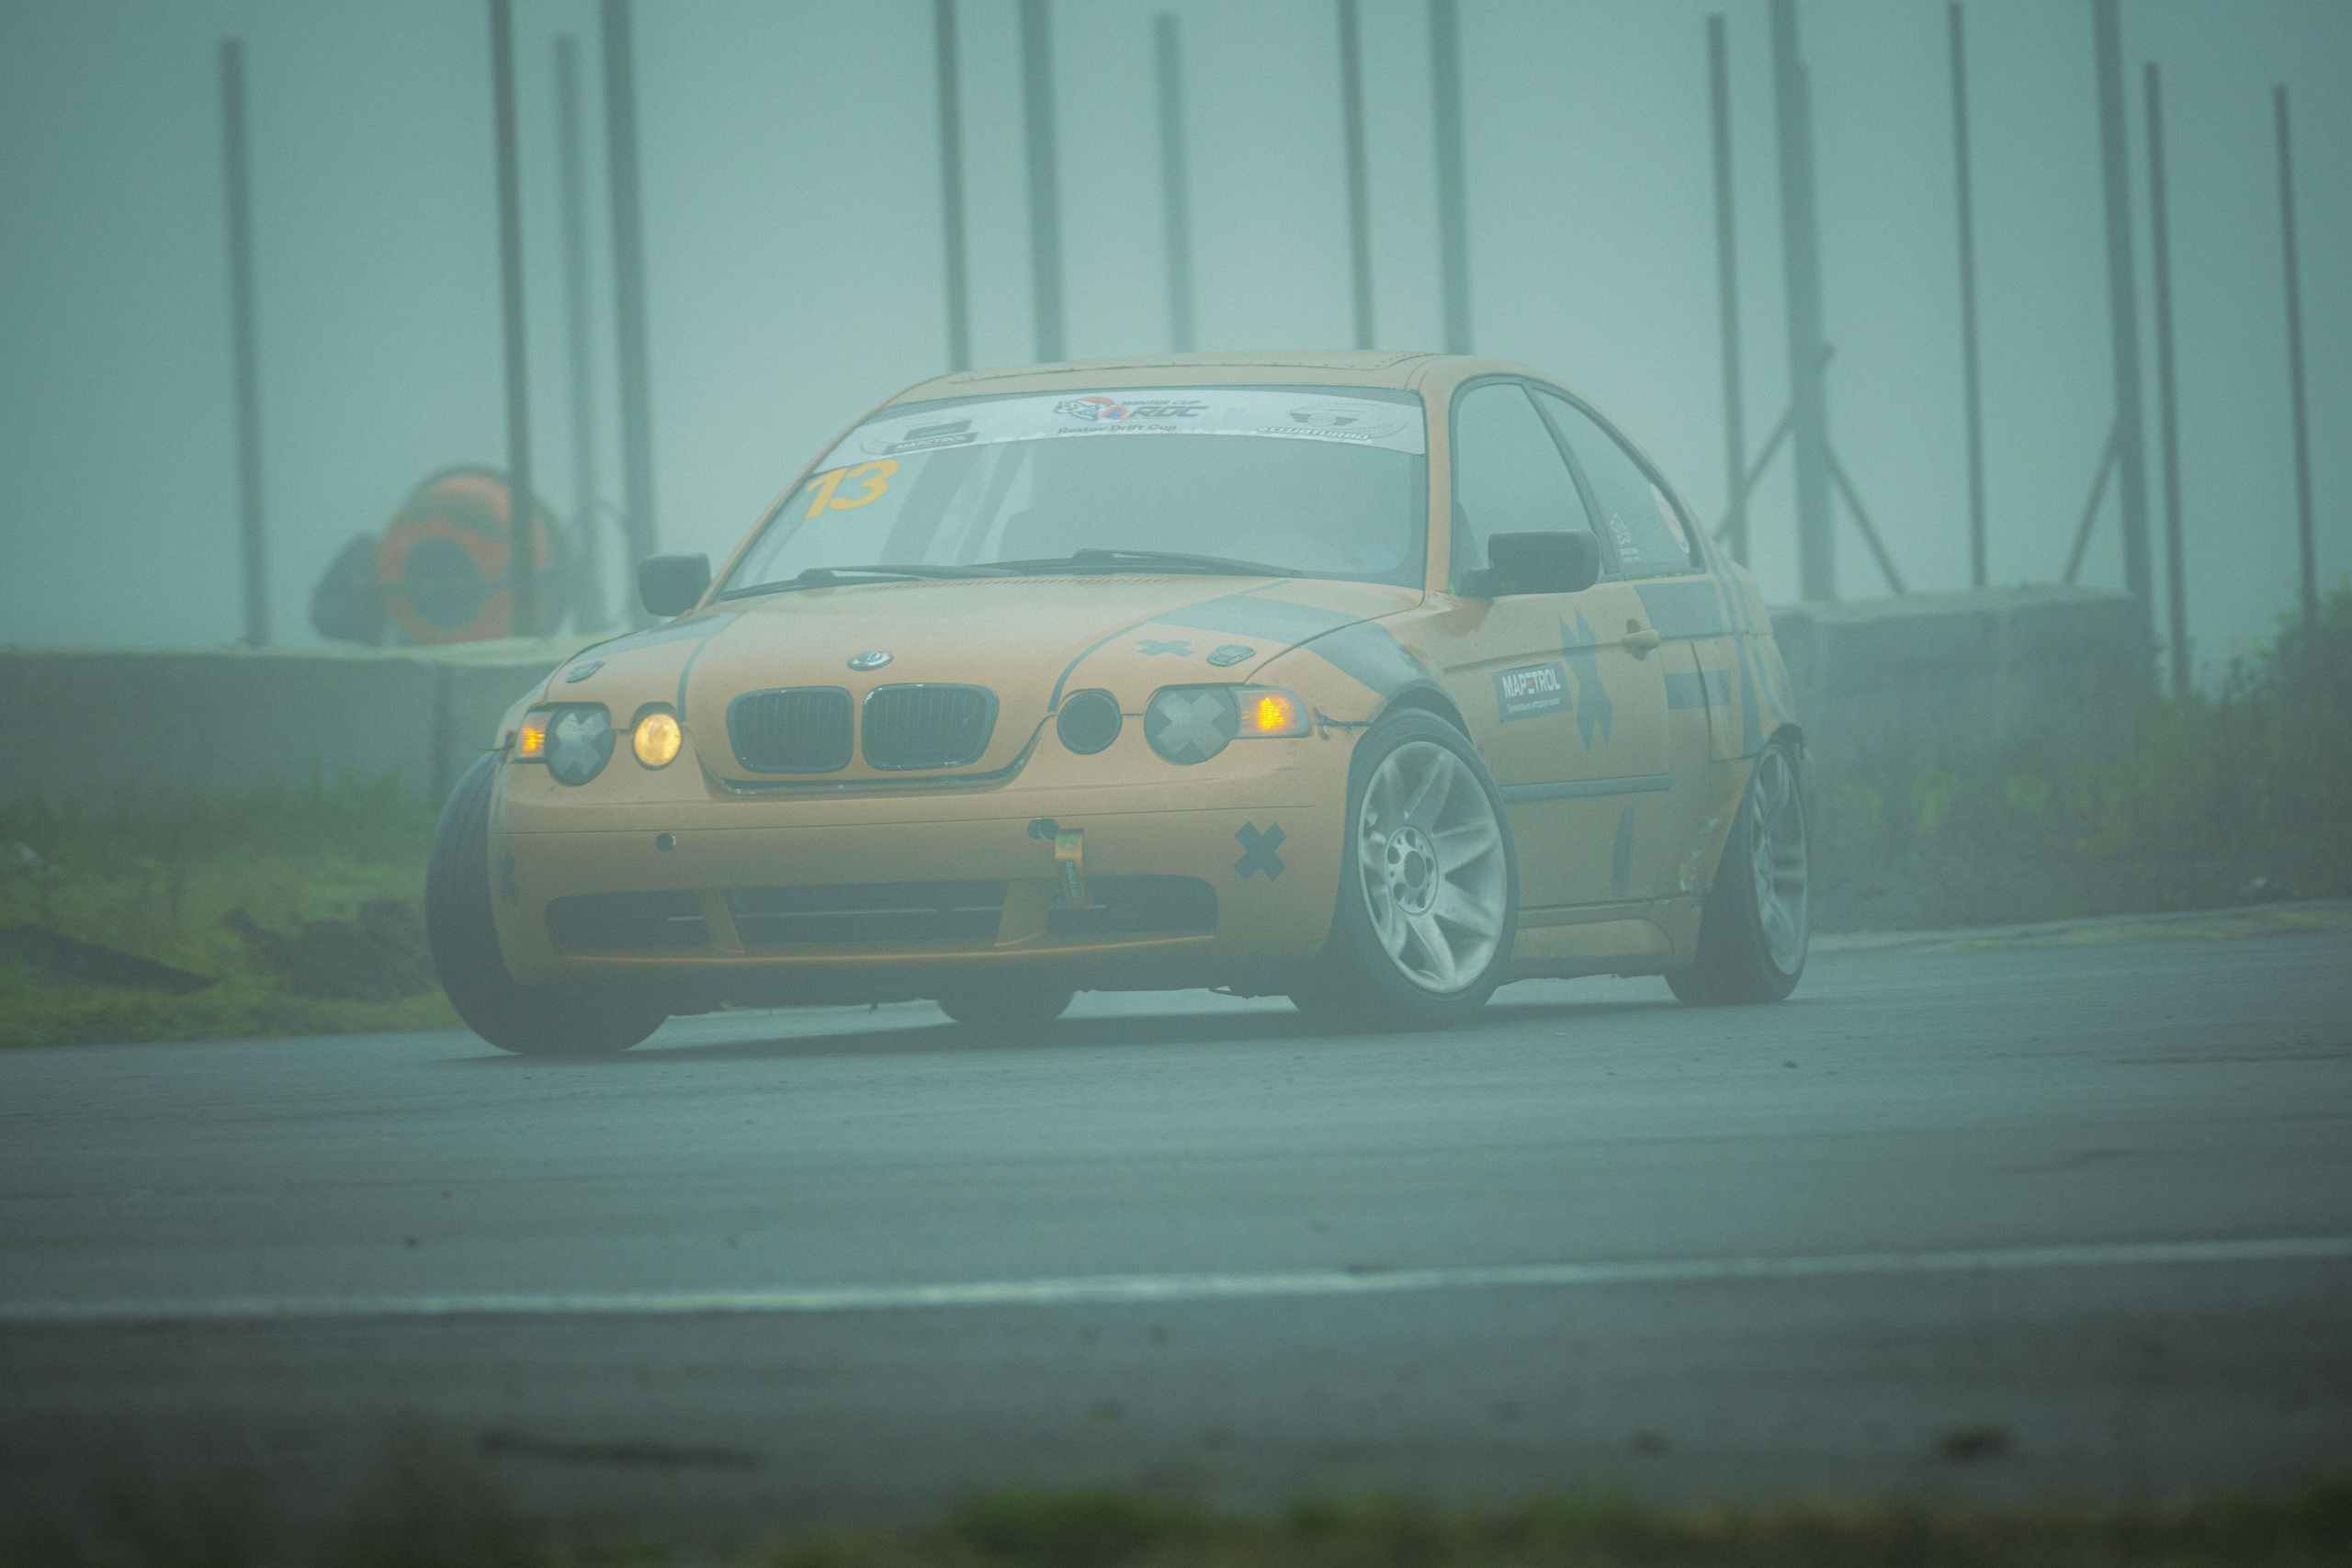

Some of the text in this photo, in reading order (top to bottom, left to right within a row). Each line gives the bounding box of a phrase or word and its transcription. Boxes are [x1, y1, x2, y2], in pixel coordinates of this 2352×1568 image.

[1128, 406, 1210, 418] RDC
[1111, 423, 1144, 432] Drift
[1148, 423, 1177, 432] Cup
[895, 435, 967, 449] MAPETROL
[805, 459, 899, 519] 13
[1501, 669, 1561, 698] MAPETROL
